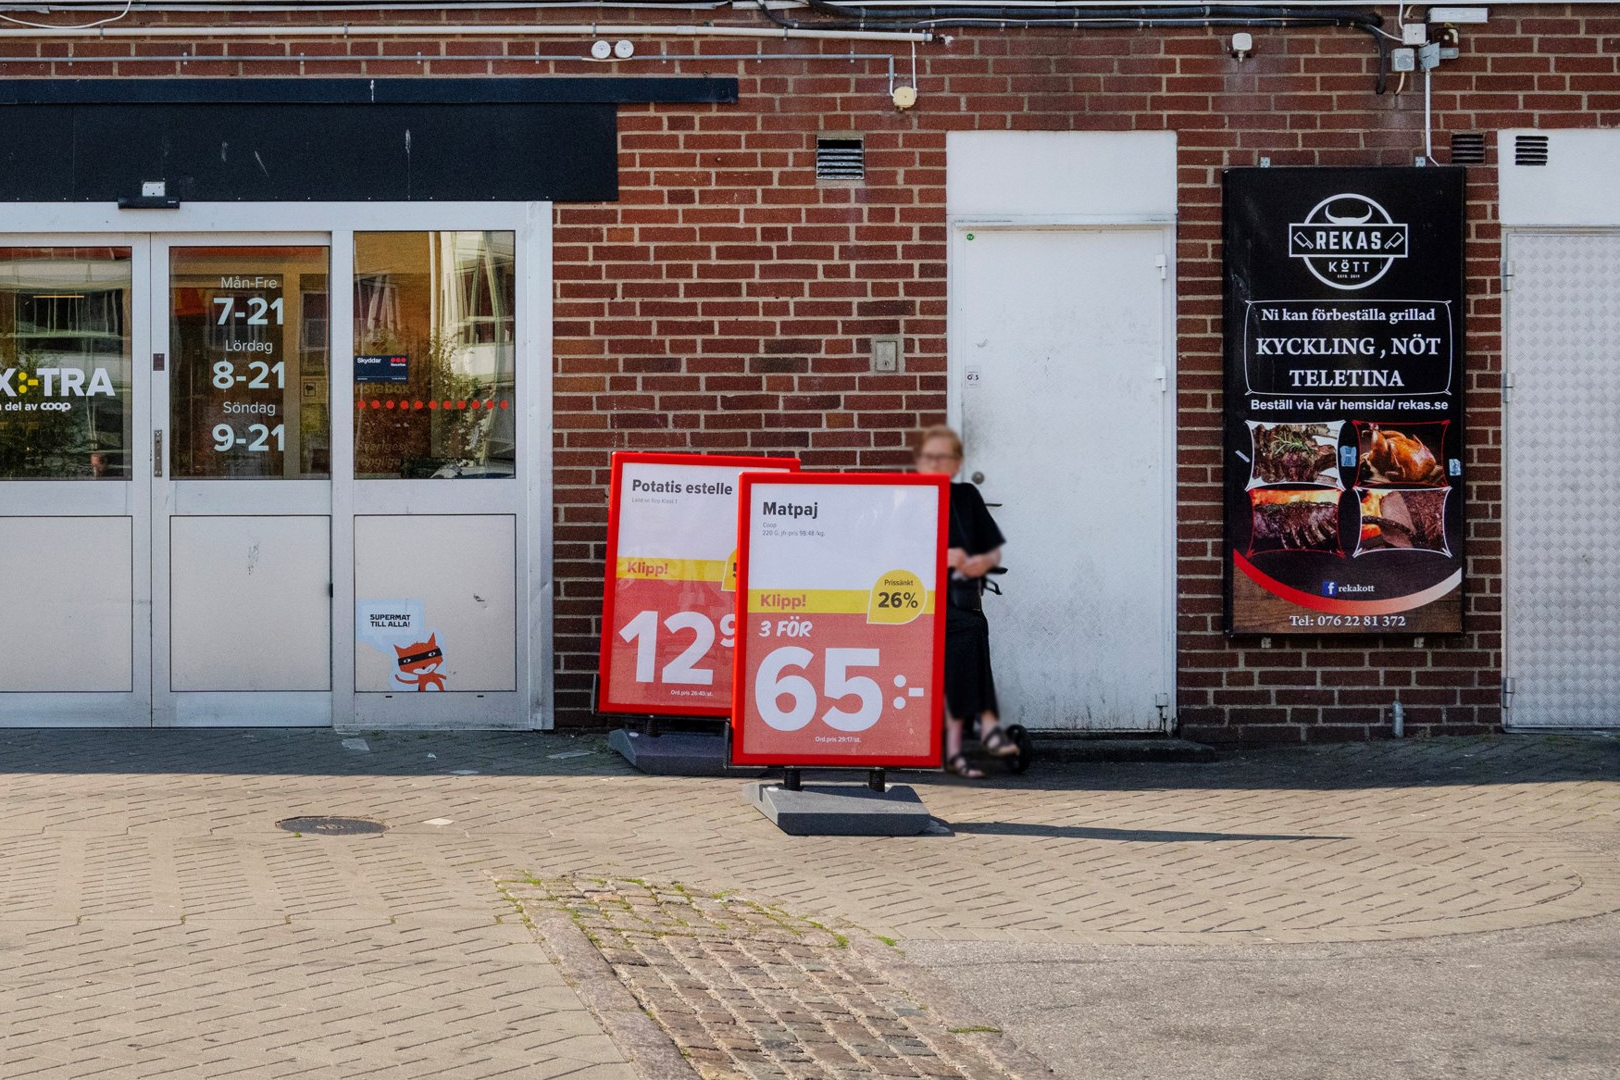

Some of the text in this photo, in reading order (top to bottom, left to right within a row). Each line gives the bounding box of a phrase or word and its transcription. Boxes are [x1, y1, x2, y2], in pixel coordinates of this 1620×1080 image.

[1316, 231, 1381, 250] REKAS
[1329, 260, 1370, 273] KÖTT
[220, 276, 277, 289] Mån-Fre
[213, 297, 284, 326] 7-21
[1261, 308, 1435, 325] Ni kan förbeställa grillad
[225, 340, 273, 355] Lördag
[1255, 338, 1375, 356] KYCKLING
[1390, 334, 1441, 356] NÖT
[212, 361, 285, 389] 8-21
[1289, 370, 1405, 387] TELETINA
[4, 402, 21, 411] del
[40, 402, 71, 412] coop
[223, 402, 276, 416] Söndag
[1251, 399, 1448, 410] Beställ via vår hemsida/ rekas.se
[212, 423, 285, 452] 9-21
[632, 479, 733, 495] Potatis estelle
[763, 502, 818, 519] Matpaj
[627, 562, 668, 576] Klipp!
[1338, 584, 1375, 592] rekakott
[760, 594, 806, 610] Klipp!
[878, 592, 918, 608] 26%
[759, 616, 812, 637] 3 FÖR
[1289, 616, 1406, 626] Tel: 076 22 81 372
